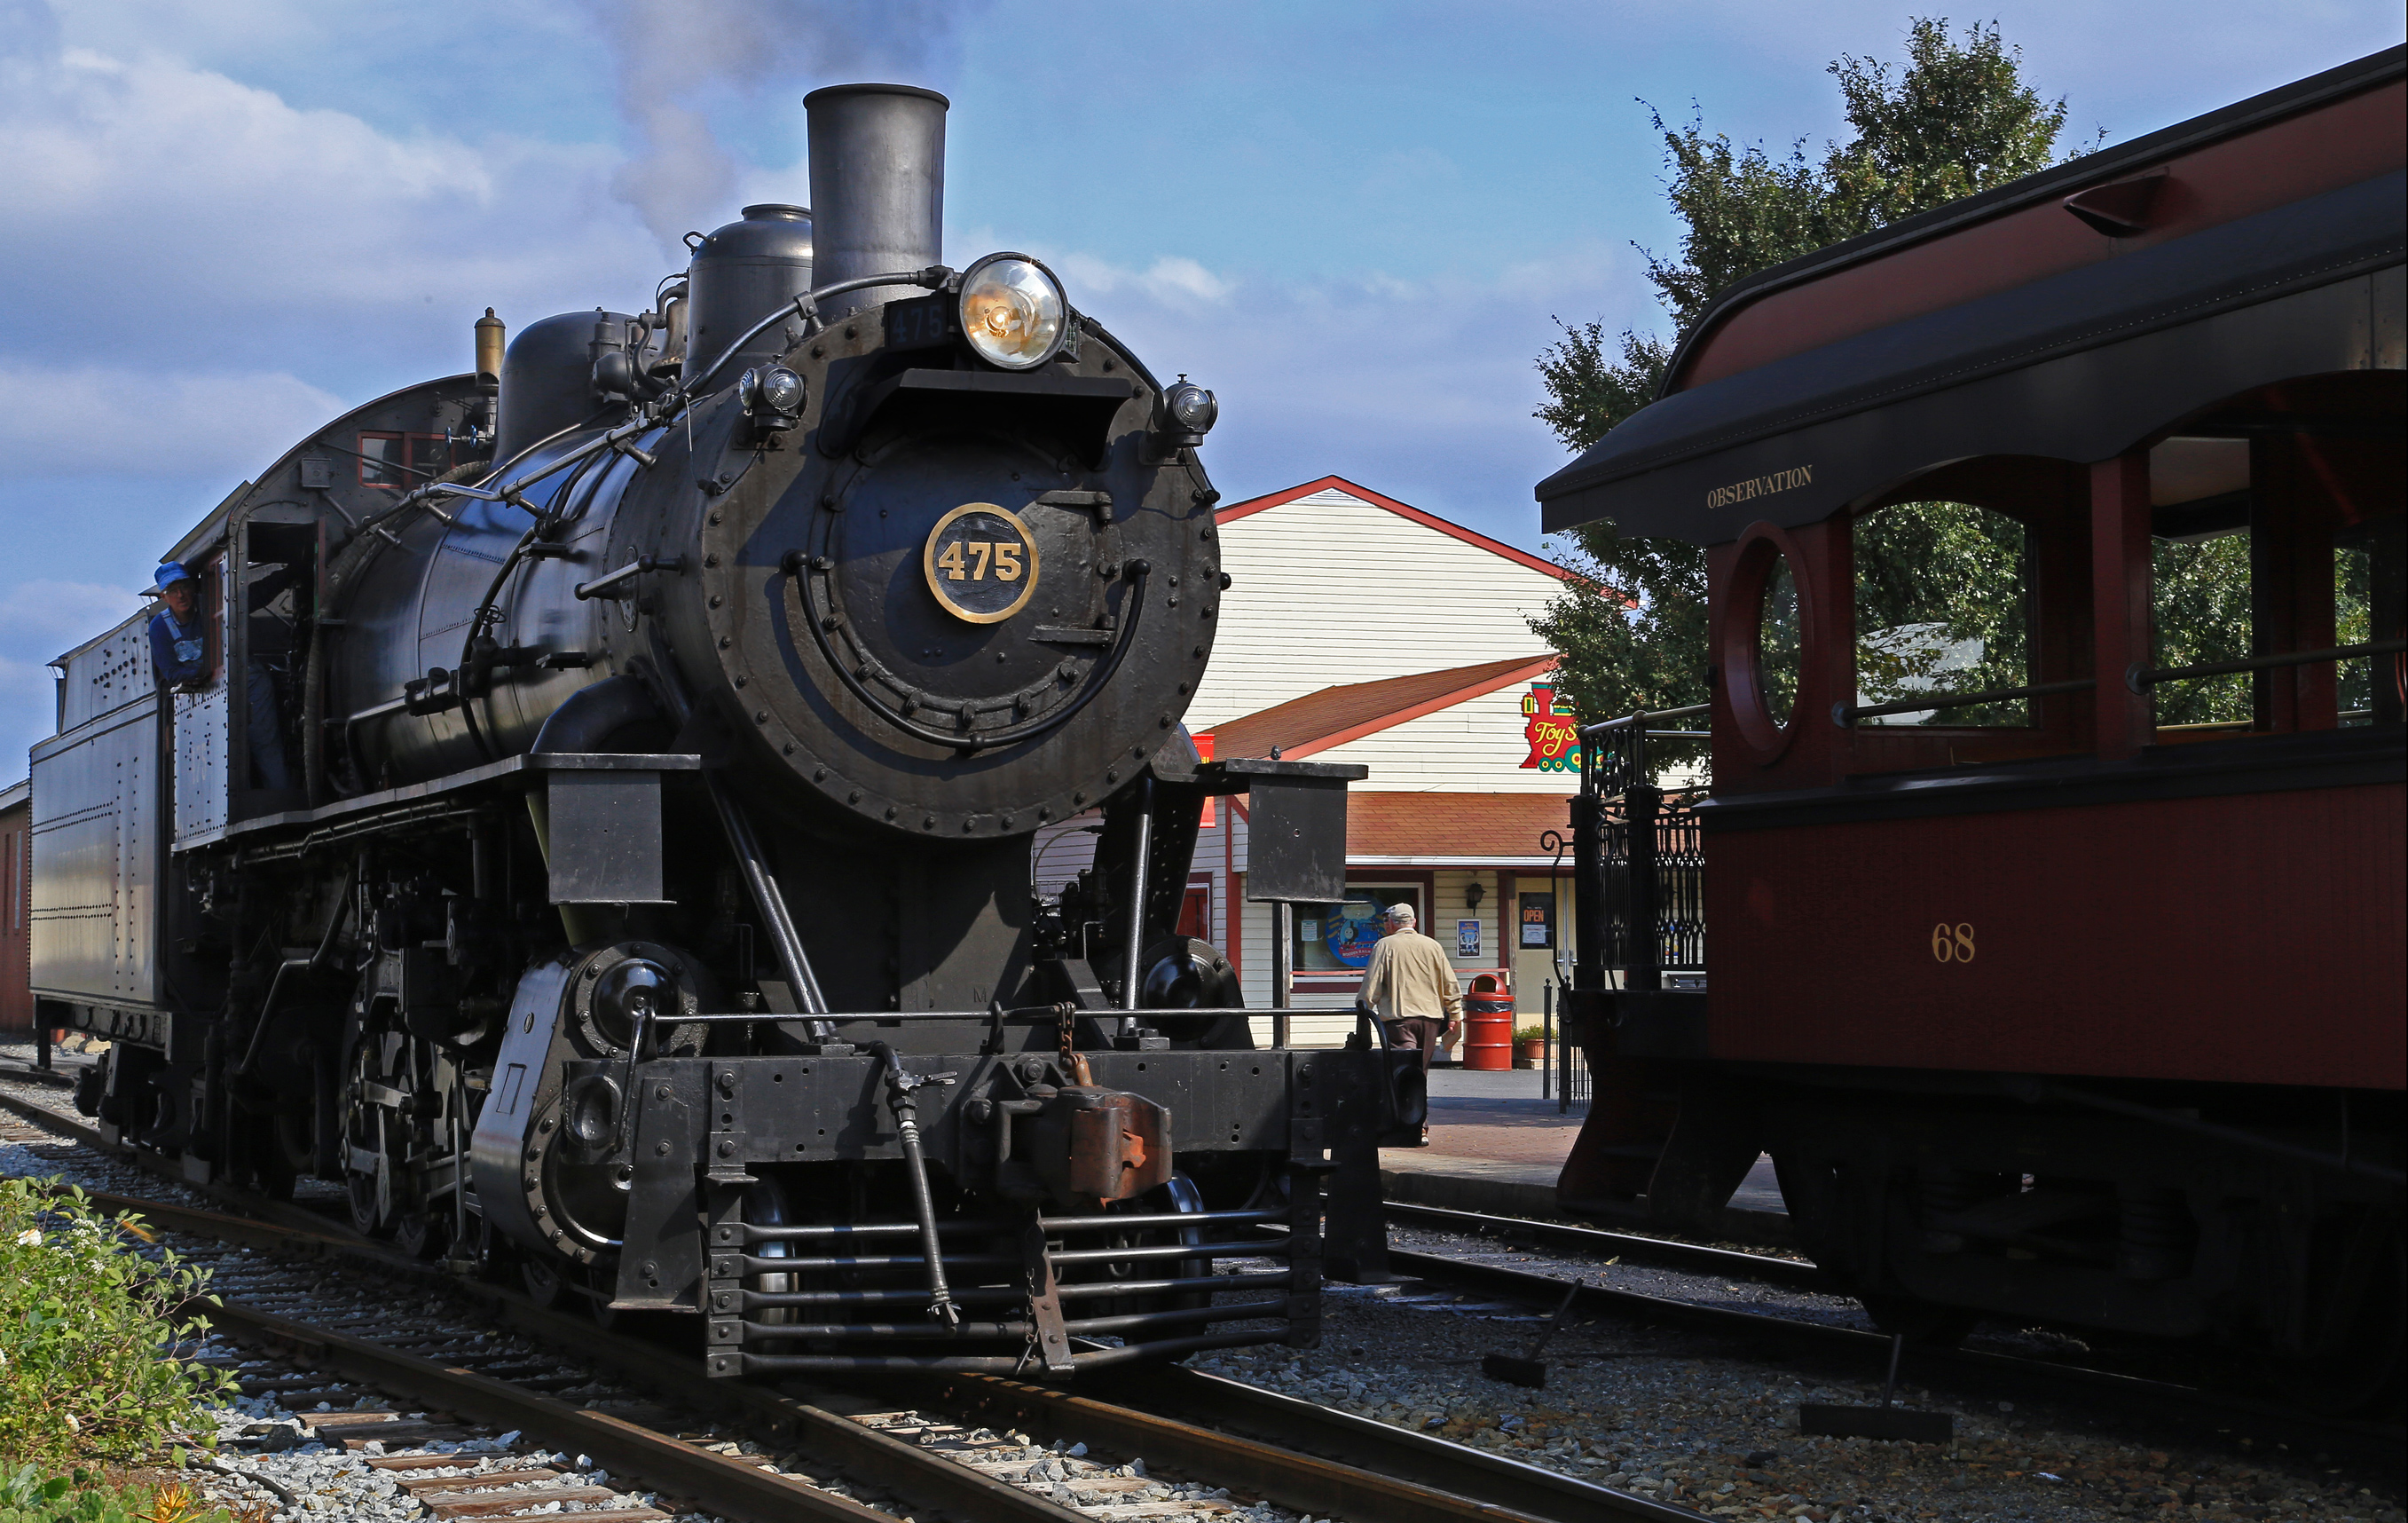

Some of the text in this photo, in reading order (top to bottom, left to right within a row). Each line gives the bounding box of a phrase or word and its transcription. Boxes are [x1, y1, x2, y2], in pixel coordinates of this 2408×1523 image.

[892, 305, 942, 343] 475
[1707, 464, 1813, 509] OBSERVATION
[938, 541, 1022, 581] 475
[1523, 909, 1545, 922] OPEN
[1932, 922, 1976, 963] 68
